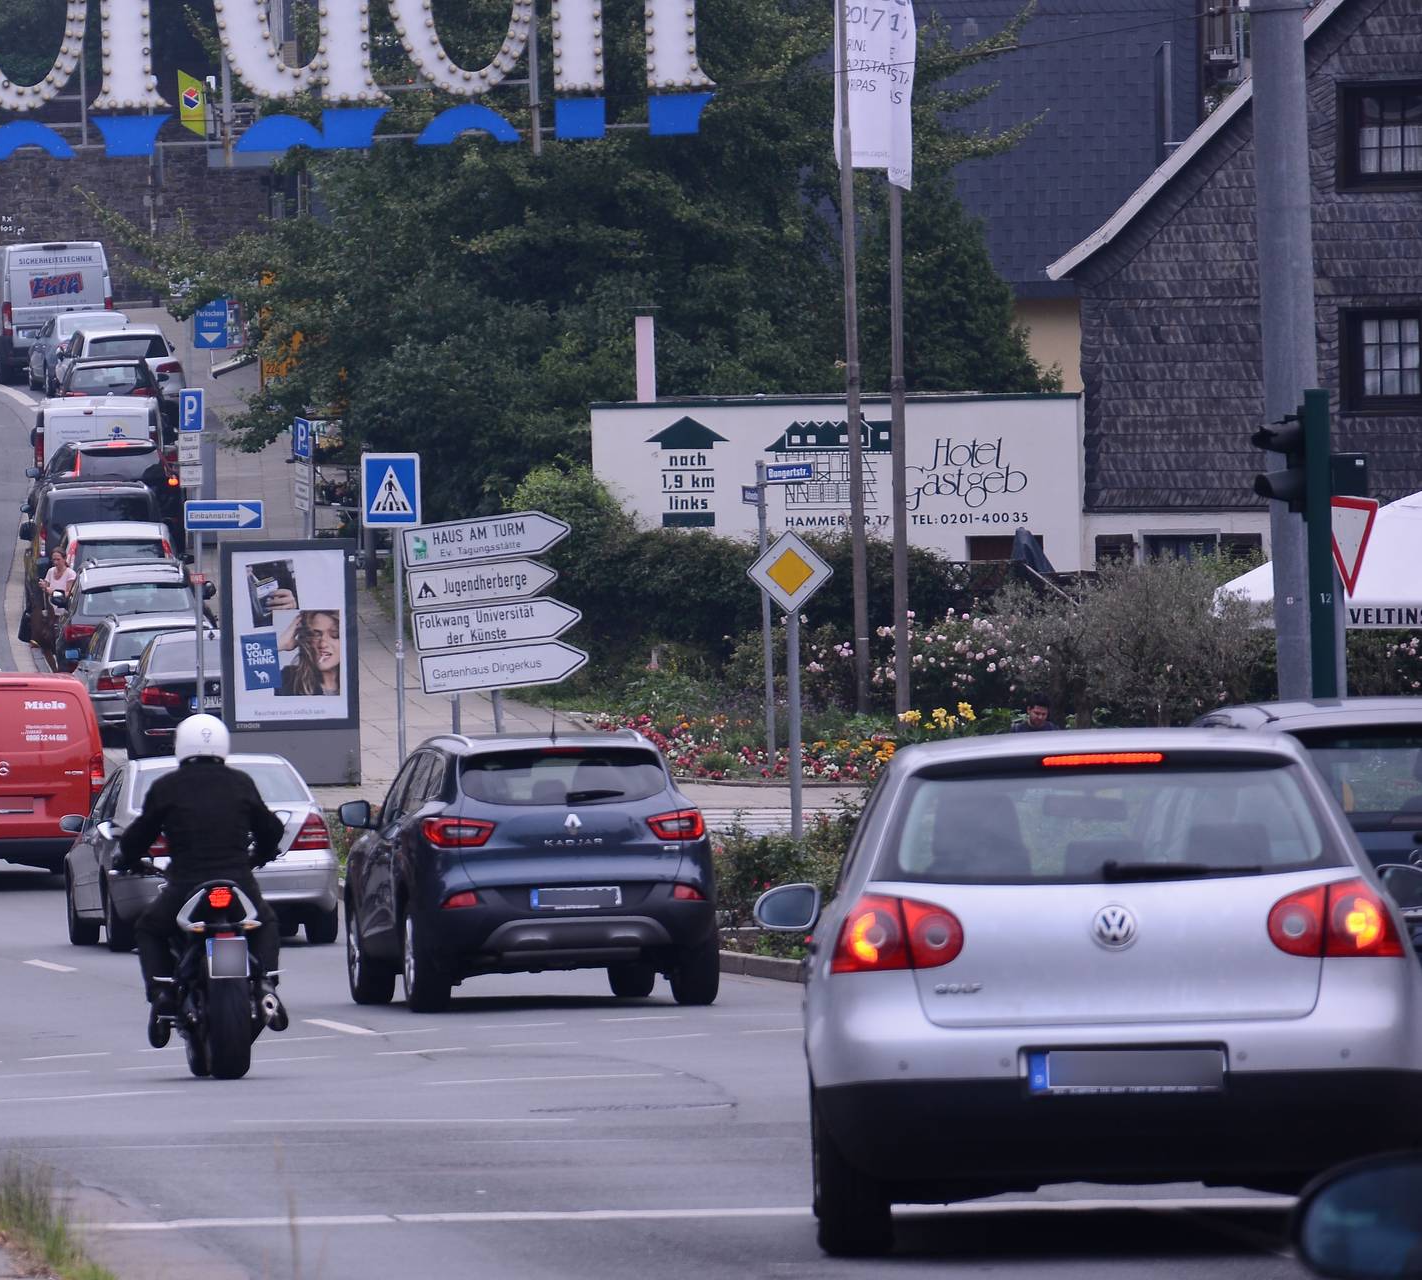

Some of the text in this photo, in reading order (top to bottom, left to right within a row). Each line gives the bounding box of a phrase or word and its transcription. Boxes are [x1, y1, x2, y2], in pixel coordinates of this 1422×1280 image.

[19, 255, 93, 265] SICHERHEITSTECHNIK
[185, 395, 197, 427] P
[669, 451, 706, 466] nach
[923, 437, 1010, 471] Hotel
[661, 474, 715, 490] 1,9 km
[669, 496, 709, 510] links
[189, 511, 240, 519] Einbahnstraße
[785, 515, 845, 527] HAMMER
[432, 521, 526, 545] HAUS AM TURM
[458, 540, 521, 556] Tagungsstätte
[443, 573, 527, 597] Jugendherberge
[1320, 592, 1332, 604] 12
[419, 604, 535, 630] Folkwang Universität
[1349, 608, 1422, 624] VELTIN
[446, 628, 507, 645] der Künste
[245, 642, 261, 651] DO
[246, 649, 273, 659] YOUR
[247, 656, 276, 666] THING
[432, 659, 542, 680] Gartenhaus Dingerkus
[24, 701, 67, 710] Miele
[544, 837, 603, 847] KADJAR
[934, 983, 983, 995] GOLF
